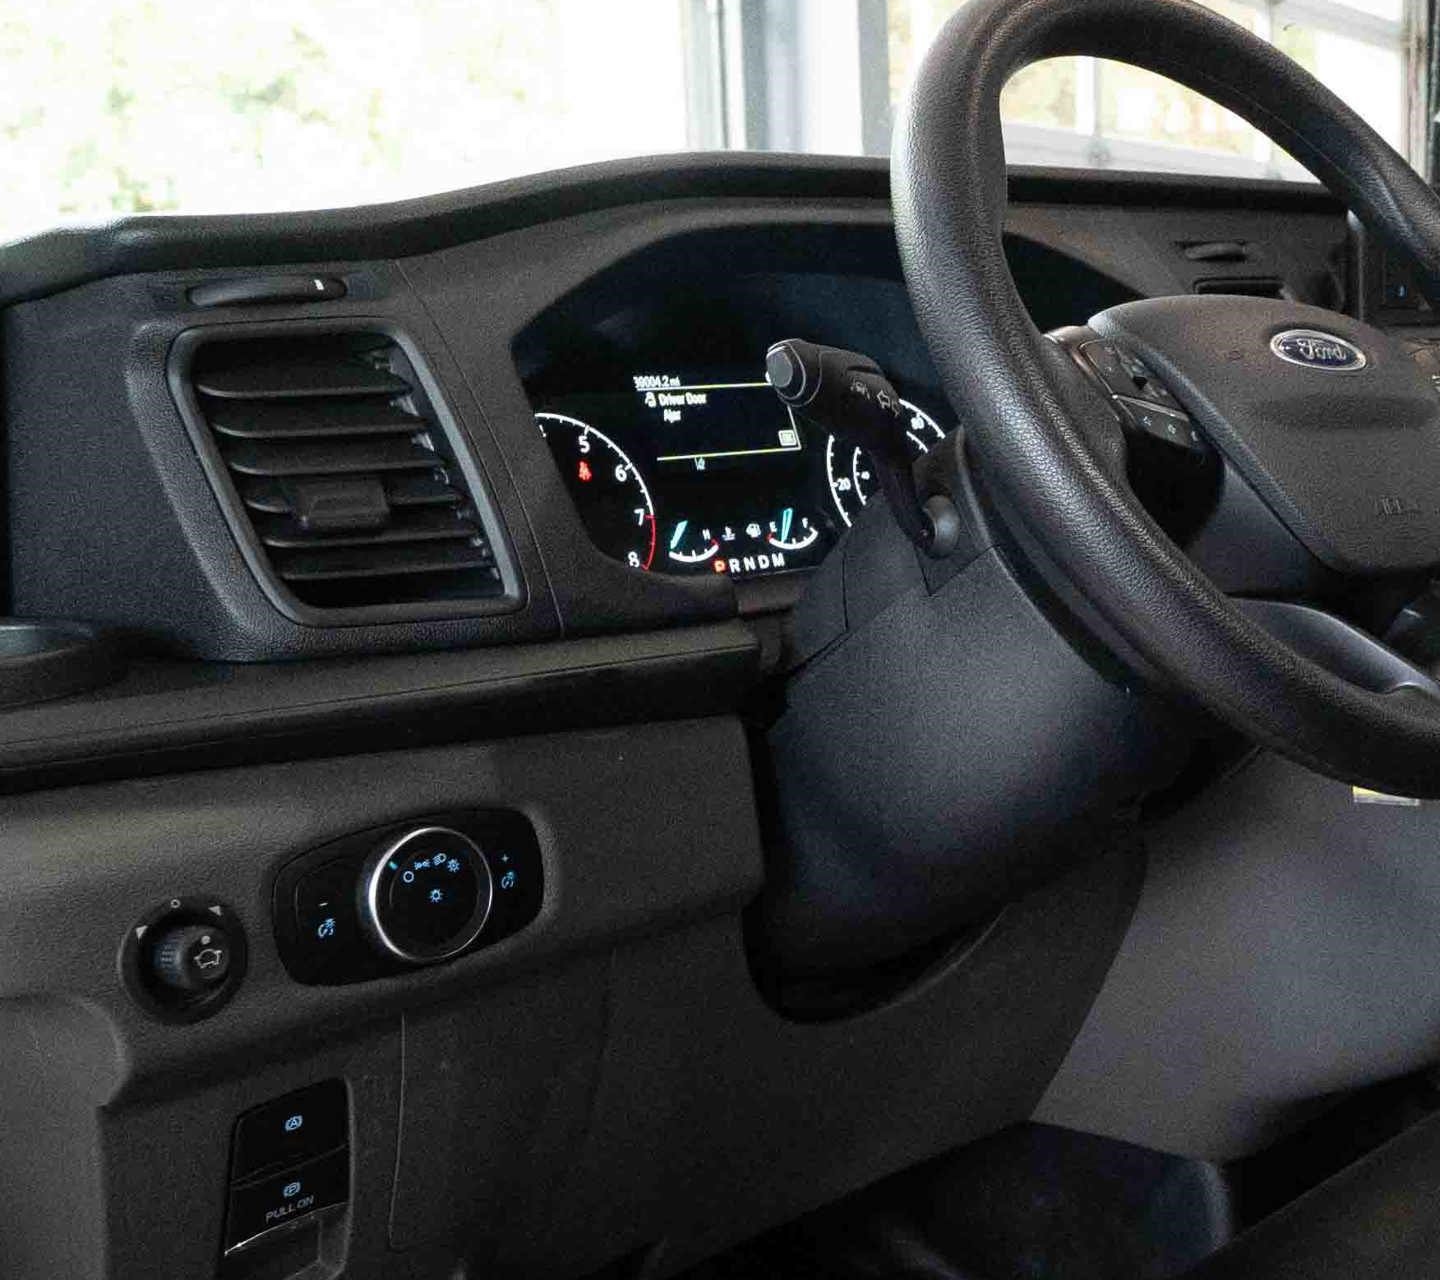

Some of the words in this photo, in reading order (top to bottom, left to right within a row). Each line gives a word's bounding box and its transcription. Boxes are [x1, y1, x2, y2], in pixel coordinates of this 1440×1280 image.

[1296, 338, 1348, 361] Ford
[685, 392, 707, 405] Door
[578, 435, 591, 454] 5
[615, 464, 628, 482] 6
[837, 477, 852, 491] 20
[634, 508, 645, 526] 7
[628, 551, 640, 568] 8
[729, 558, 741, 573] R
[743, 556, 756, 571] N
[759, 554, 770, 569] D
[772, 552, 785, 567] M
[265, 1203, 296, 1224] PULL
[297, 1194, 314, 1209] ON
